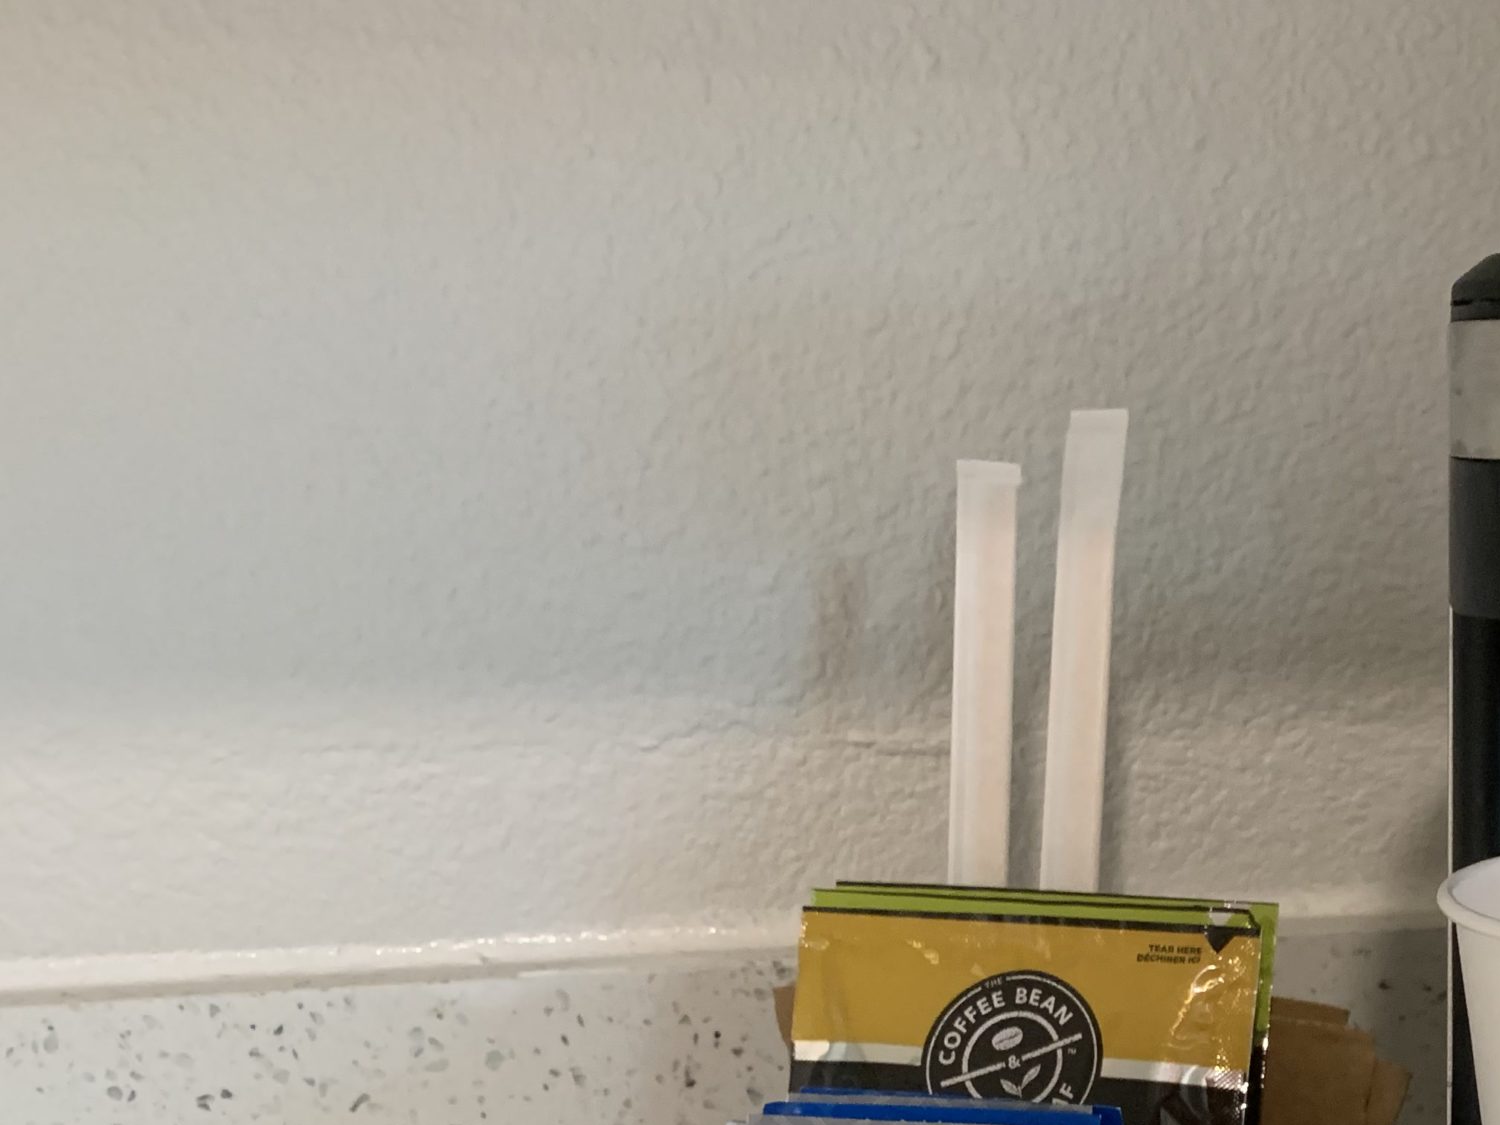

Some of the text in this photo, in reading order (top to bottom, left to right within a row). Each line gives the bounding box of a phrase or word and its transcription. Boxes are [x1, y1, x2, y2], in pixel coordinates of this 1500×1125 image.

[1177, 947, 1202, 955] HERE
[984, 977, 1004, 989] THE
[938, 986, 1074, 1066] COFFEE BEAN
[1008, 1055, 1021, 1070] &
